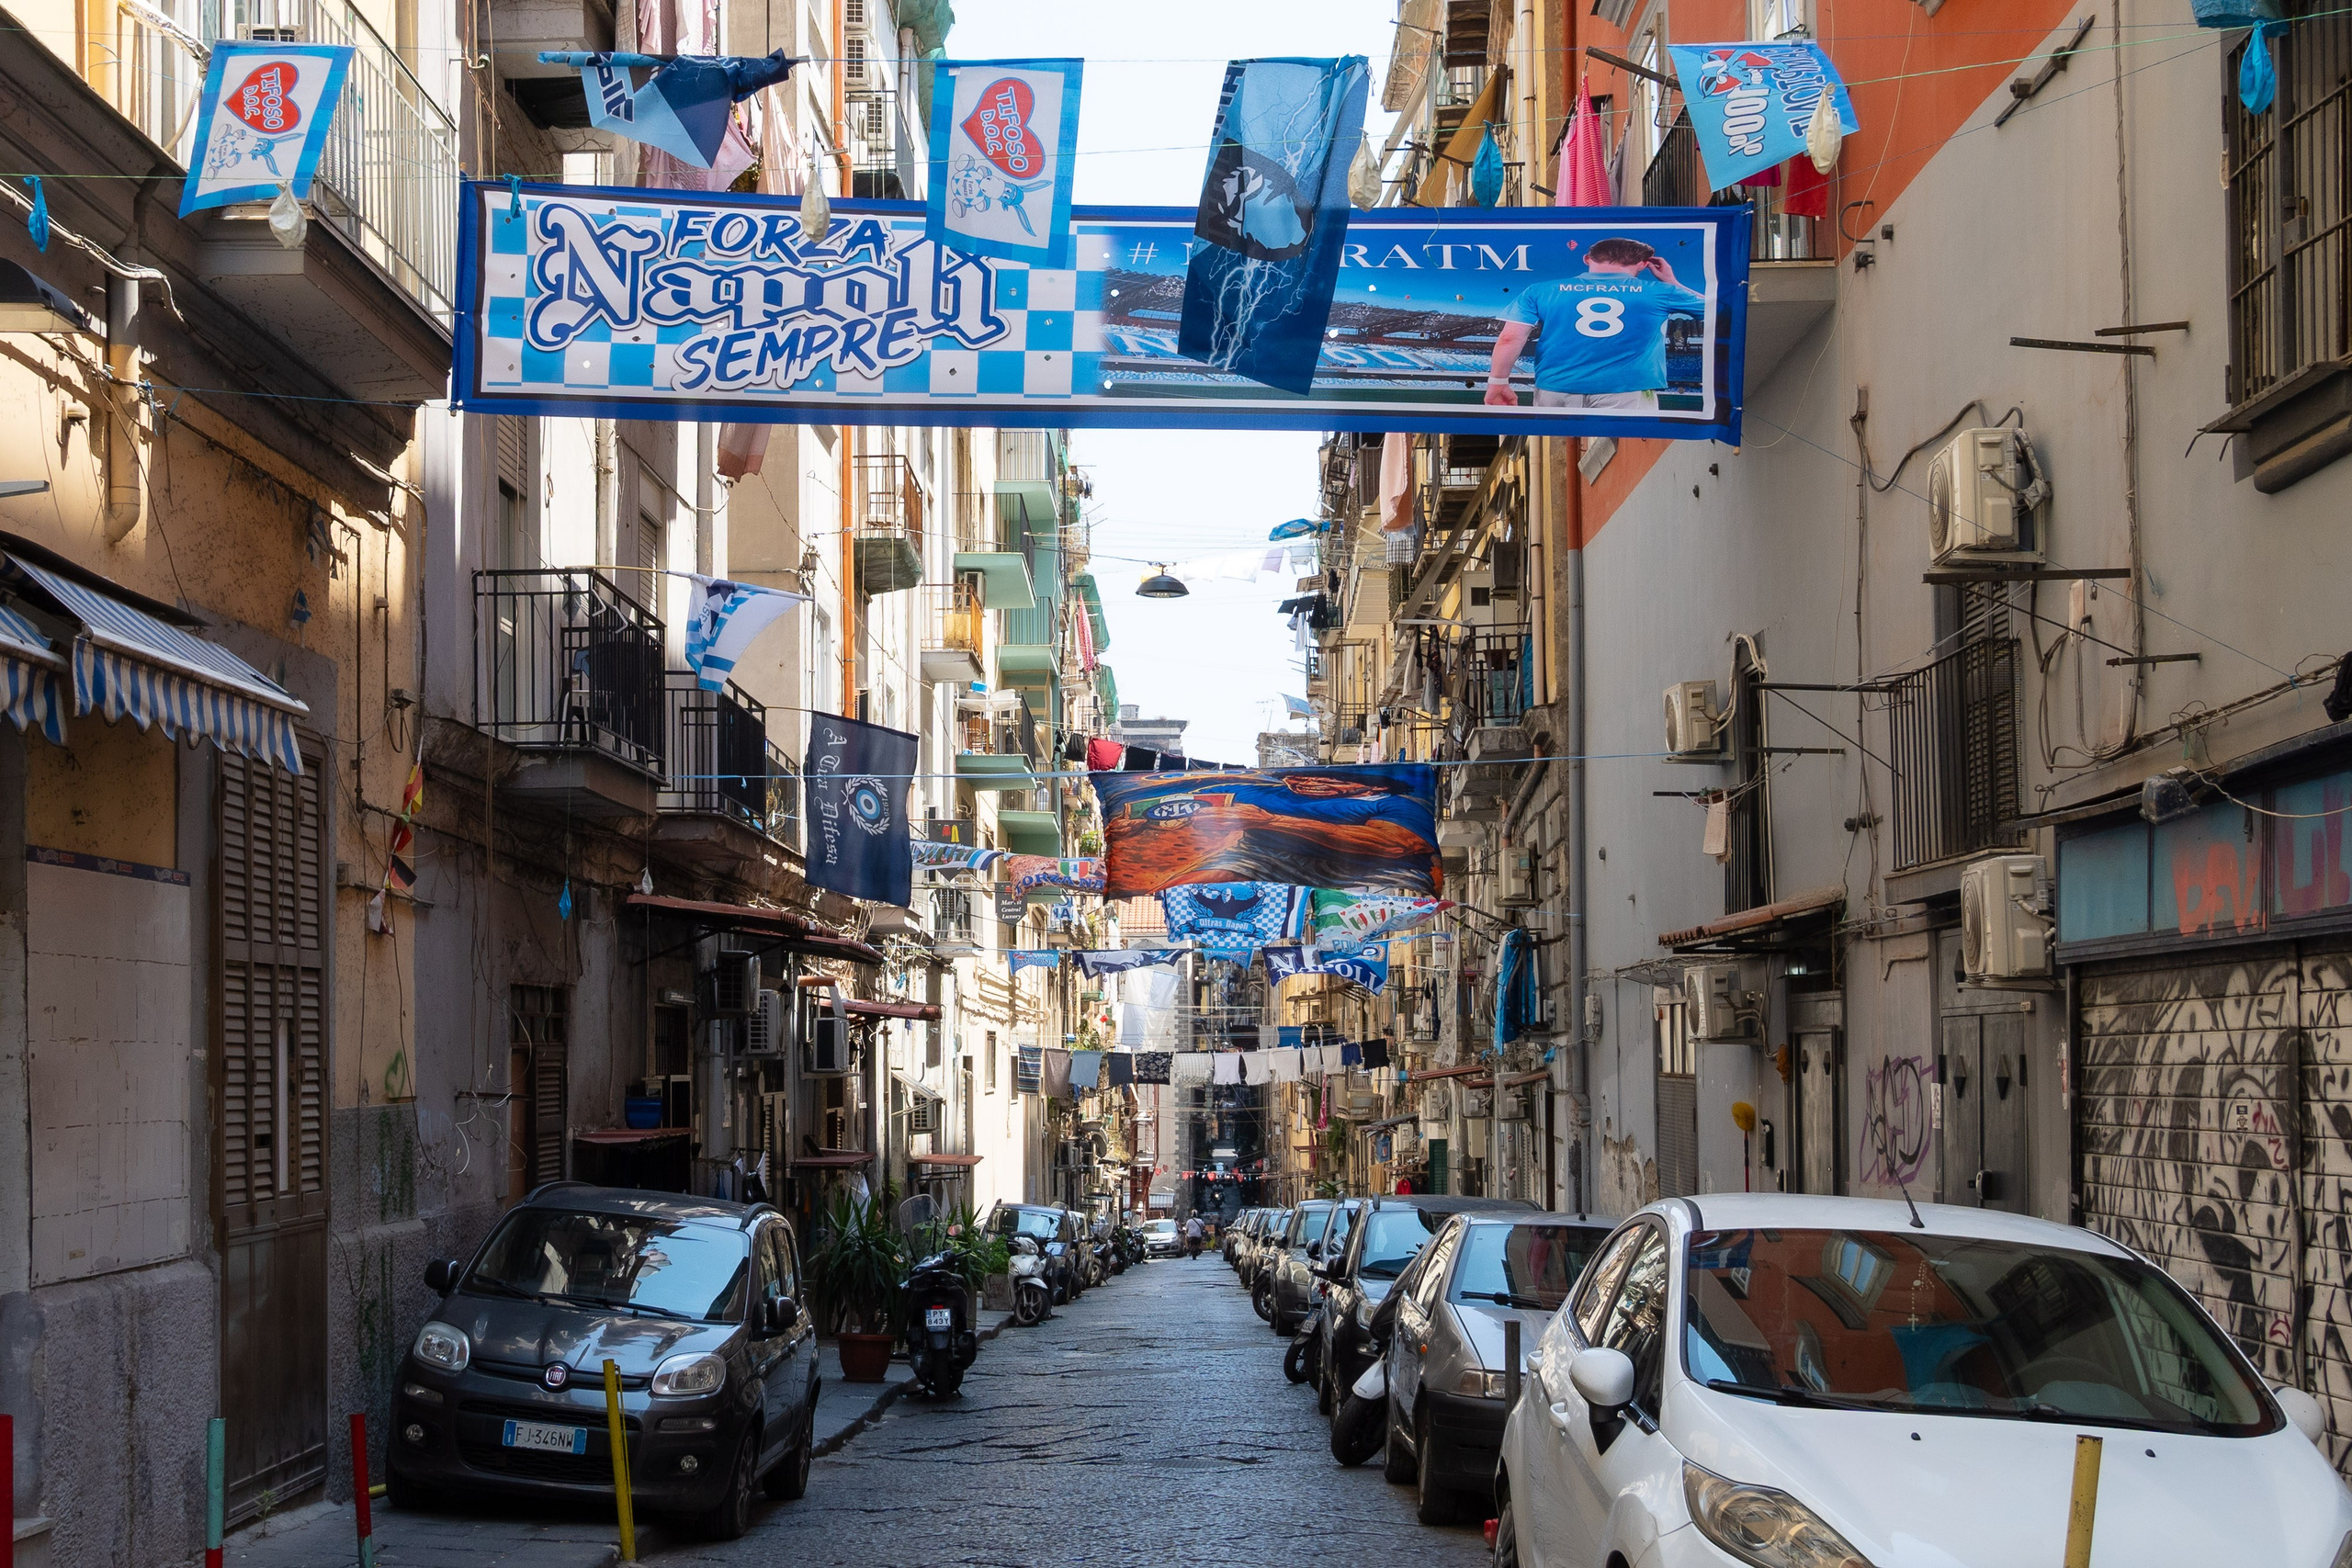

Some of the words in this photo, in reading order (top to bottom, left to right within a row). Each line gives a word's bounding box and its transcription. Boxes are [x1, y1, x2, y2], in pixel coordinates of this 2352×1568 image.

[260, 67, 284, 130] TIFOSO
[1722, 86, 1771, 157] 100%
[996, 86, 1028, 172] TIFOSO
[668, 207, 893, 267] FORZA
[1127, 242, 1159, 265] #
[526, 200, 1011, 351] Napoli
[1558, 282, 1644, 295] MCFRATM
[1574, 296, 1625, 338] 8
[673, 307, 922, 392] SEMPRE
[822, 727, 847, 746] A
[813, 795, 842, 866] Difesa
[1199, 919, 1223, 928] Ultras
[1226, 919, 1249, 931] Napoli
[549, 1371, 563, 1381] FIAT
